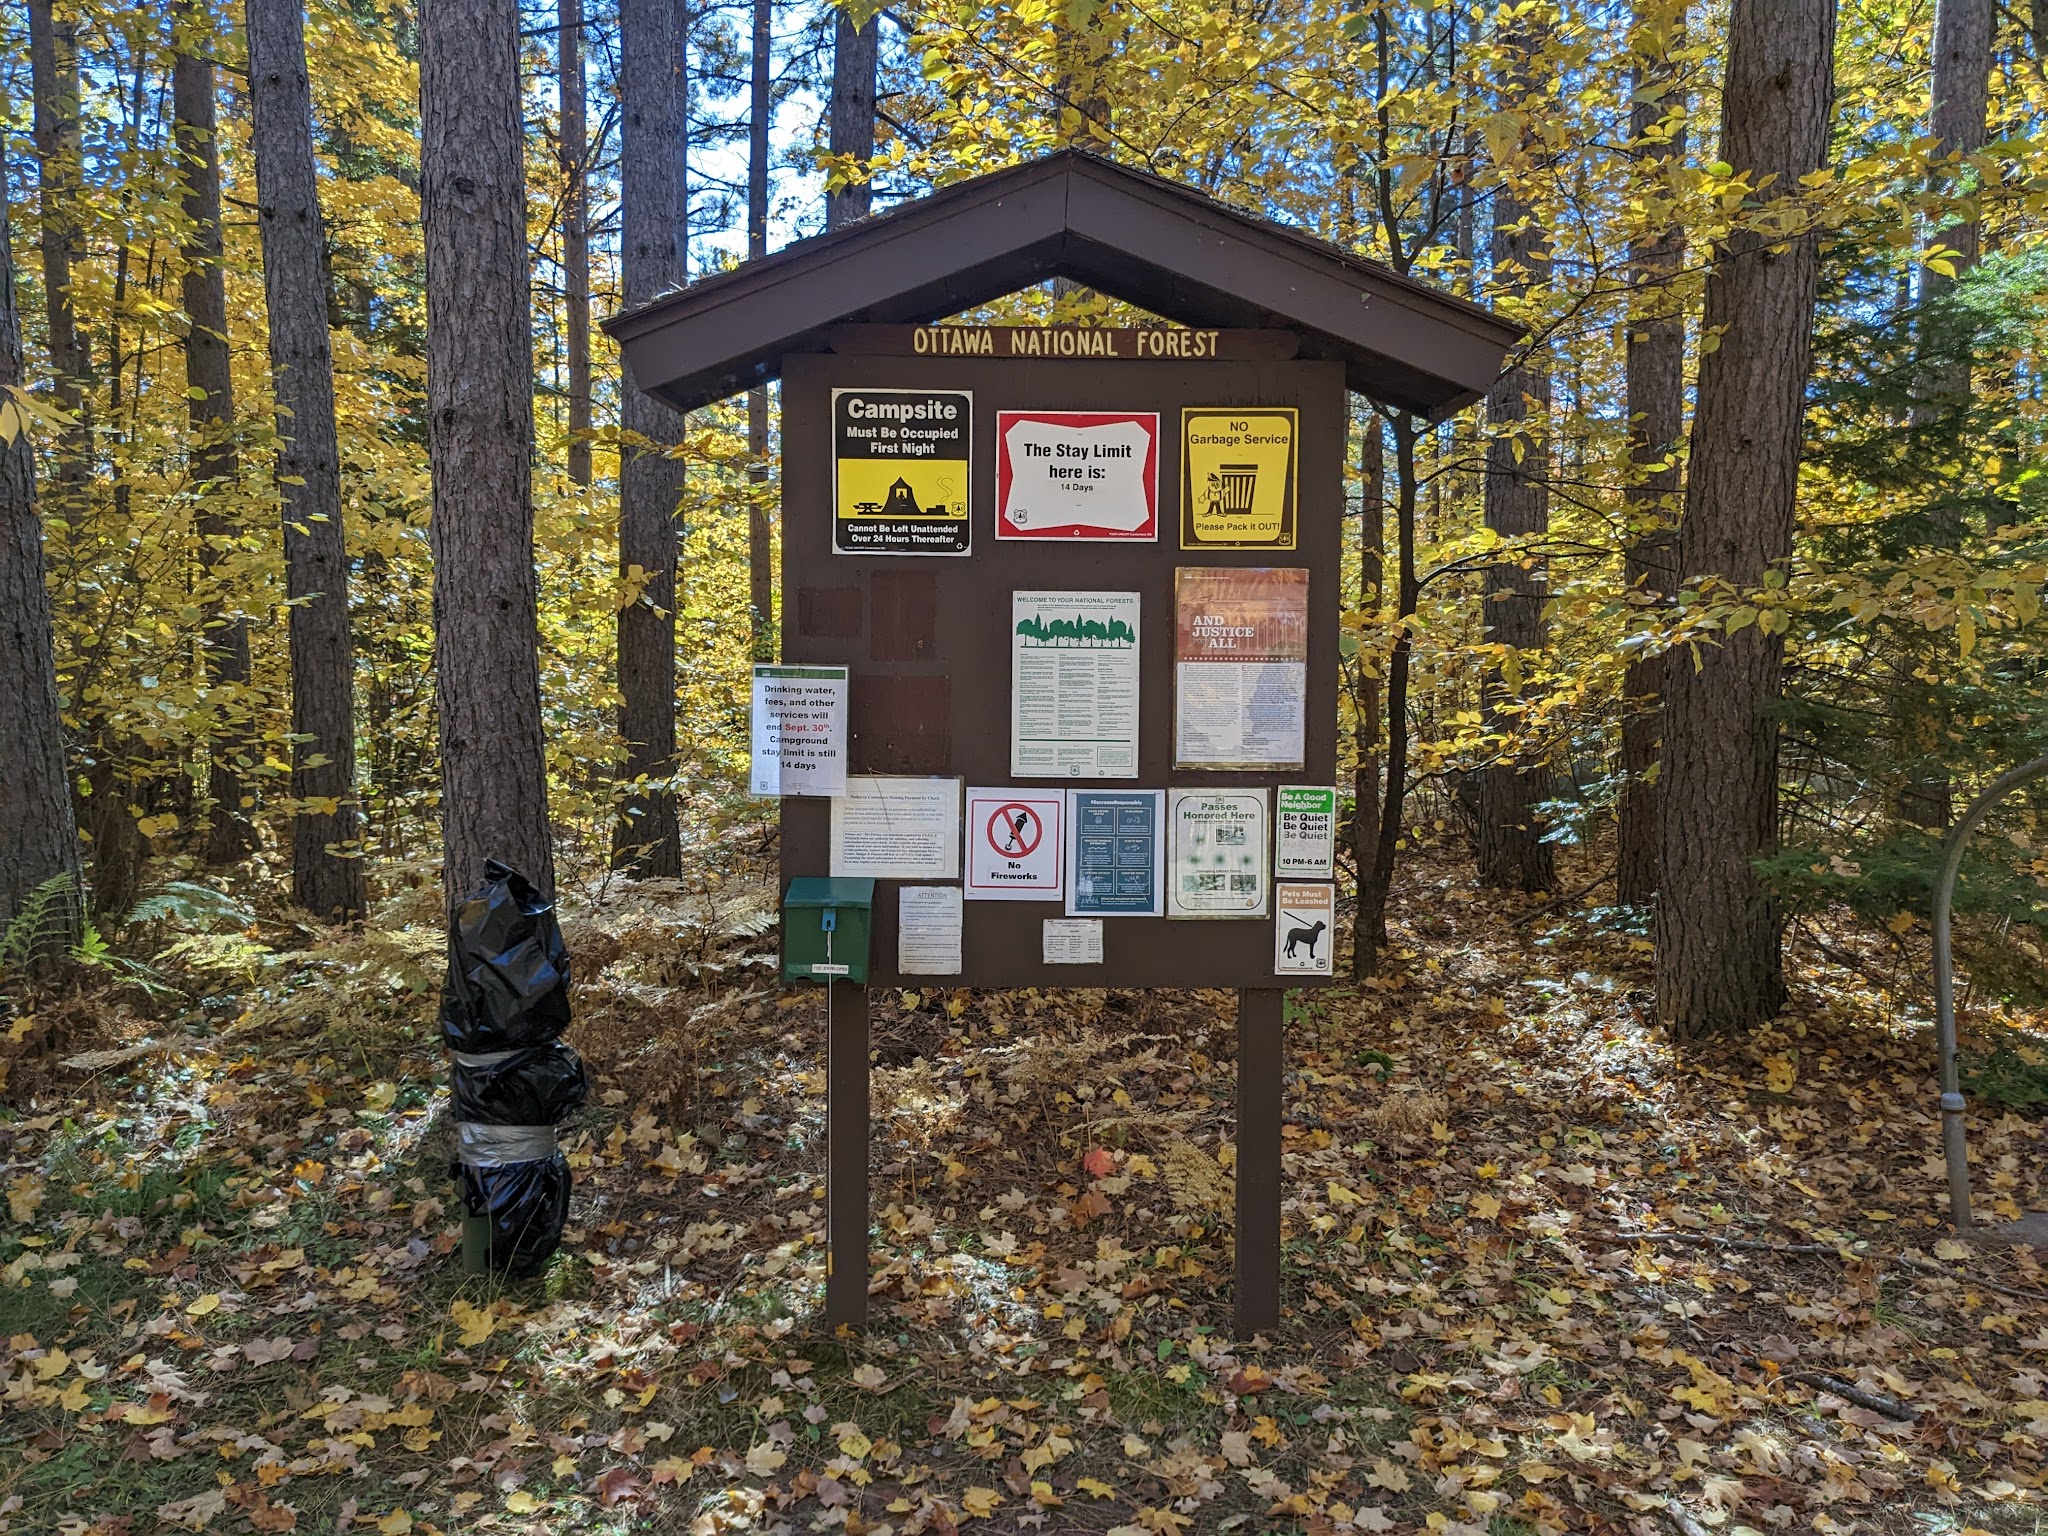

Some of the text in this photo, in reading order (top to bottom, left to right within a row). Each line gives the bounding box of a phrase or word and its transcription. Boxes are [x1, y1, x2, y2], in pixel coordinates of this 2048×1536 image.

[913, 327, 1219, 358] OTTAWA NATIONAL FOREST
[848, 398, 958, 424] Campsite
[1230, 421, 1249, 432] NO
[846, 426, 959, 440] Must Be Occupied
[1190, 434, 1289, 446] Garbage Service
[870, 442, 936, 456] First Night
[1023, 443, 1132, 460] The Stay Limit
[1049, 465, 1106, 479] here is:
[1060, 483, 1094, 492] 14 Days
[848, 524, 958, 533] Cannot Be Left Unattended
[1196, 522, 1280, 531] Please Pack it OUT!
[851, 534, 955, 544] Over 24 Hours Thereafter
[1192, 616, 1224, 626] AND
[1192, 626, 1254, 638] JUSTICE
[1208, 638, 1236, 648] ALL
[764, 685, 836, 696] Drinking water,
[765, 698, 787, 707] fees,
[785, 724, 810, 732] Sept.
[770, 736, 828, 745] Campground
[762, 748, 780, 758] stay
[784, 748, 804, 757] limit
[818, 750, 836, 758] still
[794, 762, 816, 770] days
[1201, 802, 1238, 810] Passes
[1281, 801, 1321, 809] Neighbor
[1300, 814, 1328, 822] Quiet
[1284, 822, 1328, 830] Be Quiet
[1299, 831, 1327, 839] Quiet
[991, 872, 1038, 880] Fireworks
